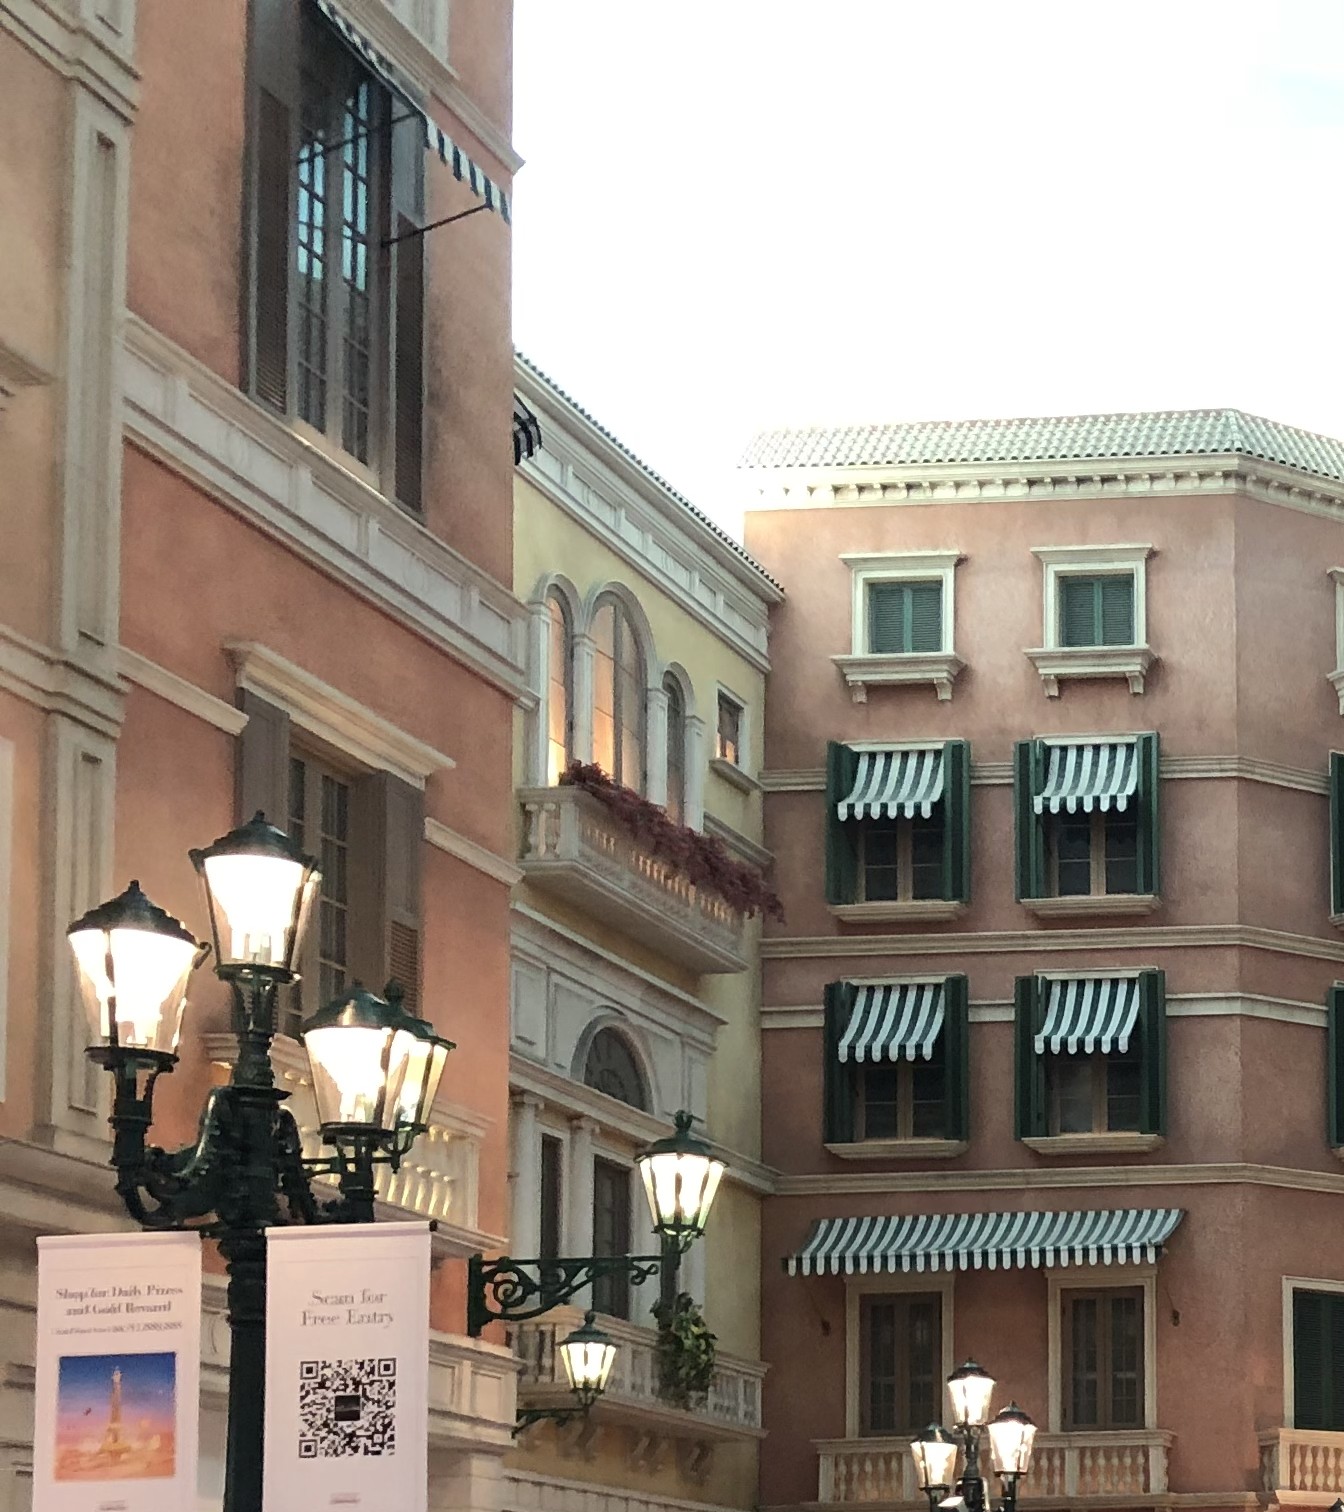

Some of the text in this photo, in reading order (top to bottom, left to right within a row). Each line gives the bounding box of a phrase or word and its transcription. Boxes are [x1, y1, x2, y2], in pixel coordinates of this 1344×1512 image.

[311, 1288, 388, 1305] Scan for
[301, 1309, 394, 1329] Free Entry
